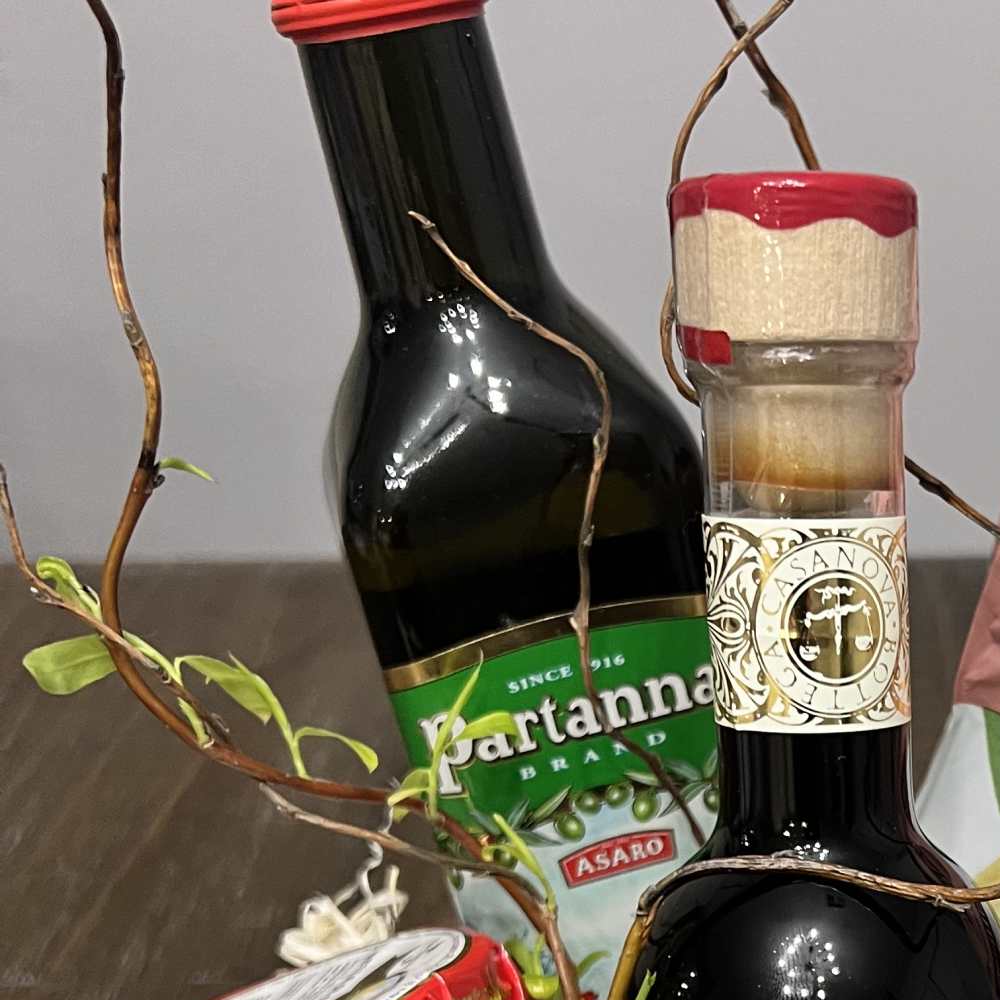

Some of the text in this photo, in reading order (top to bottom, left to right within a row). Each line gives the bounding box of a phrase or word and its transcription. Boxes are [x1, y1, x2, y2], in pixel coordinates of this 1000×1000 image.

[761, 546, 897, 618] CASANOVA
[506, 654, 626, 694] SINCE 916
[764, 640, 897, 710] BOTTEGA
[575, 836, 665, 878] ASARO
